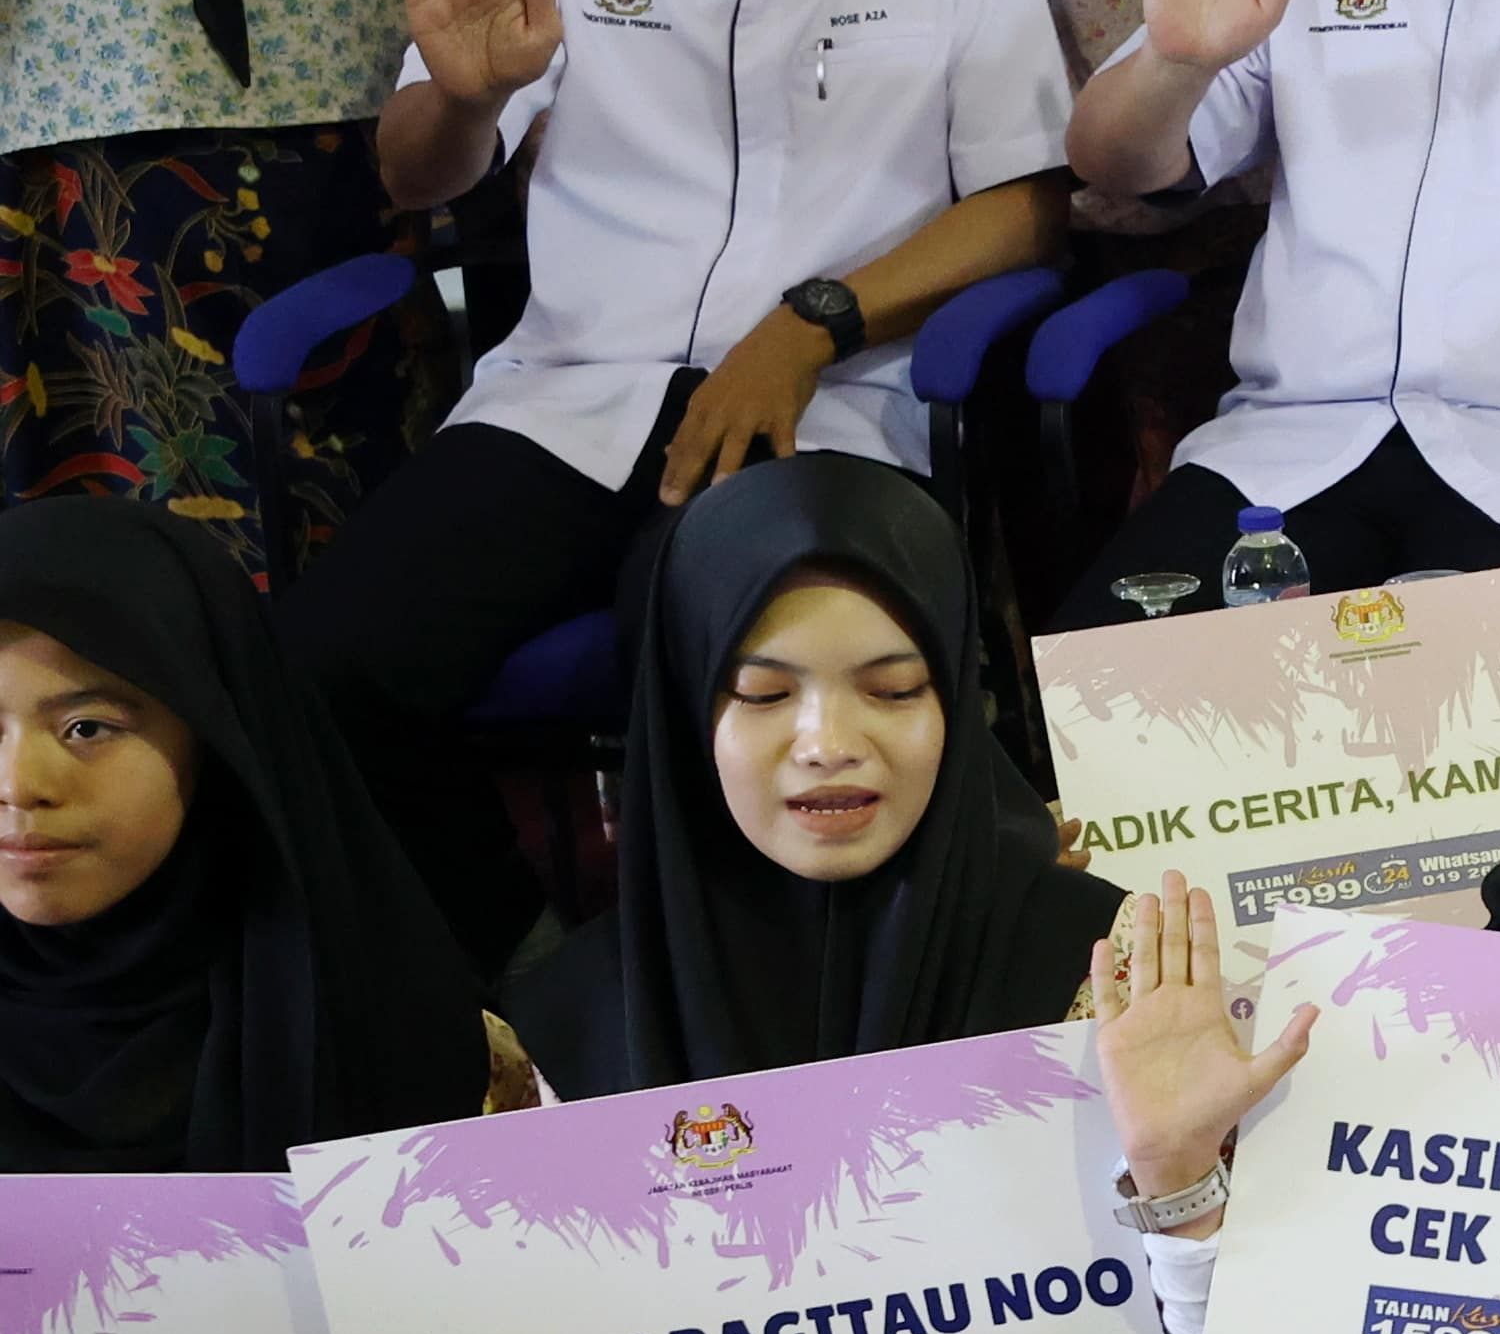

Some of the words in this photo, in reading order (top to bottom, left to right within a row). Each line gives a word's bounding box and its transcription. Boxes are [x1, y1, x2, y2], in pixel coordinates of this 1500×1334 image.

[831, 13, 860, 28] ROSE
[1081, 804, 1196, 853] ADIK
[1206, 774, 1395, 840] CERITA,
[1234, 873, 1296, 894] TALIAN
[1421, 870, 1457, 887] 019
[1367, 1202, 1492, 1265] CEK
[984, 1254, 1137, 1326] NOO
[1372, 1298, 1451, 1322] TALIAN
